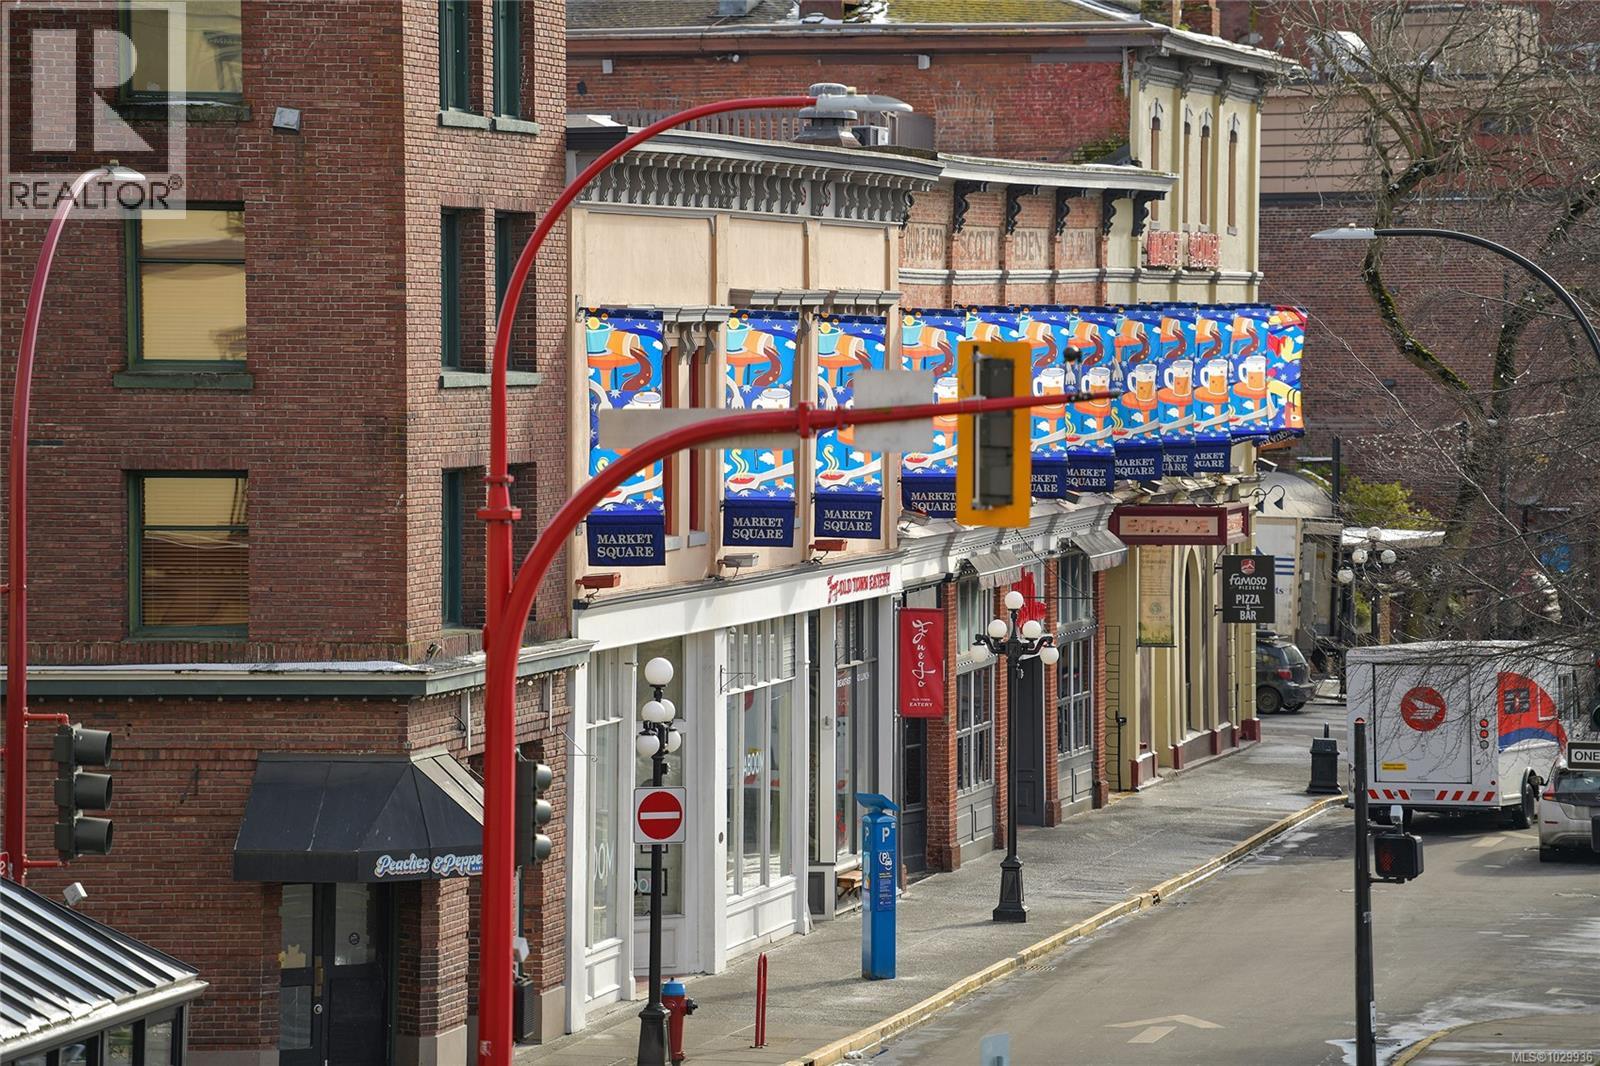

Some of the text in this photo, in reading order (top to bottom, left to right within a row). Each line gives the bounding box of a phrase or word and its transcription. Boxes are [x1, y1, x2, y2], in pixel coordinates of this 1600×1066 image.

[959, 230, 995, 261] SCOTT
[1014, 230, 1041, 261] EDEN
[1115, 458, 1155, 466] MARKET
[1162, 463, 1188, 471] UARE
[1194, 460, 1224, 468] QUARE
[1066, 469, 1106, 477] MARKET
[1114, 467, 1155, 476] SQUARE
[1031, 475, 1058, 483] RKET
[1066, 478, 1106, 487] SQUARE
[1031, 484, 1058, 492] UARE
[911, 492, 957, 501] MARKET
[911, 501, 957, 511] SQUARE
[823, 509, 873, 520] MARKET
[732, 517, 784, 527] MARKET
[823, 520, 873, 532] SQUARE
[597, 533, 653, 545] MARKET
[732, 528, 784, 540] SQUARE
[597, 546, 654, 558] SQUARE
[869, 572, 891, 590] EATERY
[1236, 594, 1261, 605] PIZZA
[1240, 611, 1257, 620] BAR
[912, 620, 936, 687] Fuego
[1574, 751, 1600, 761] ONE
[882, 827, 890, 843] P
[374, 853, 430, 877] Peaches
